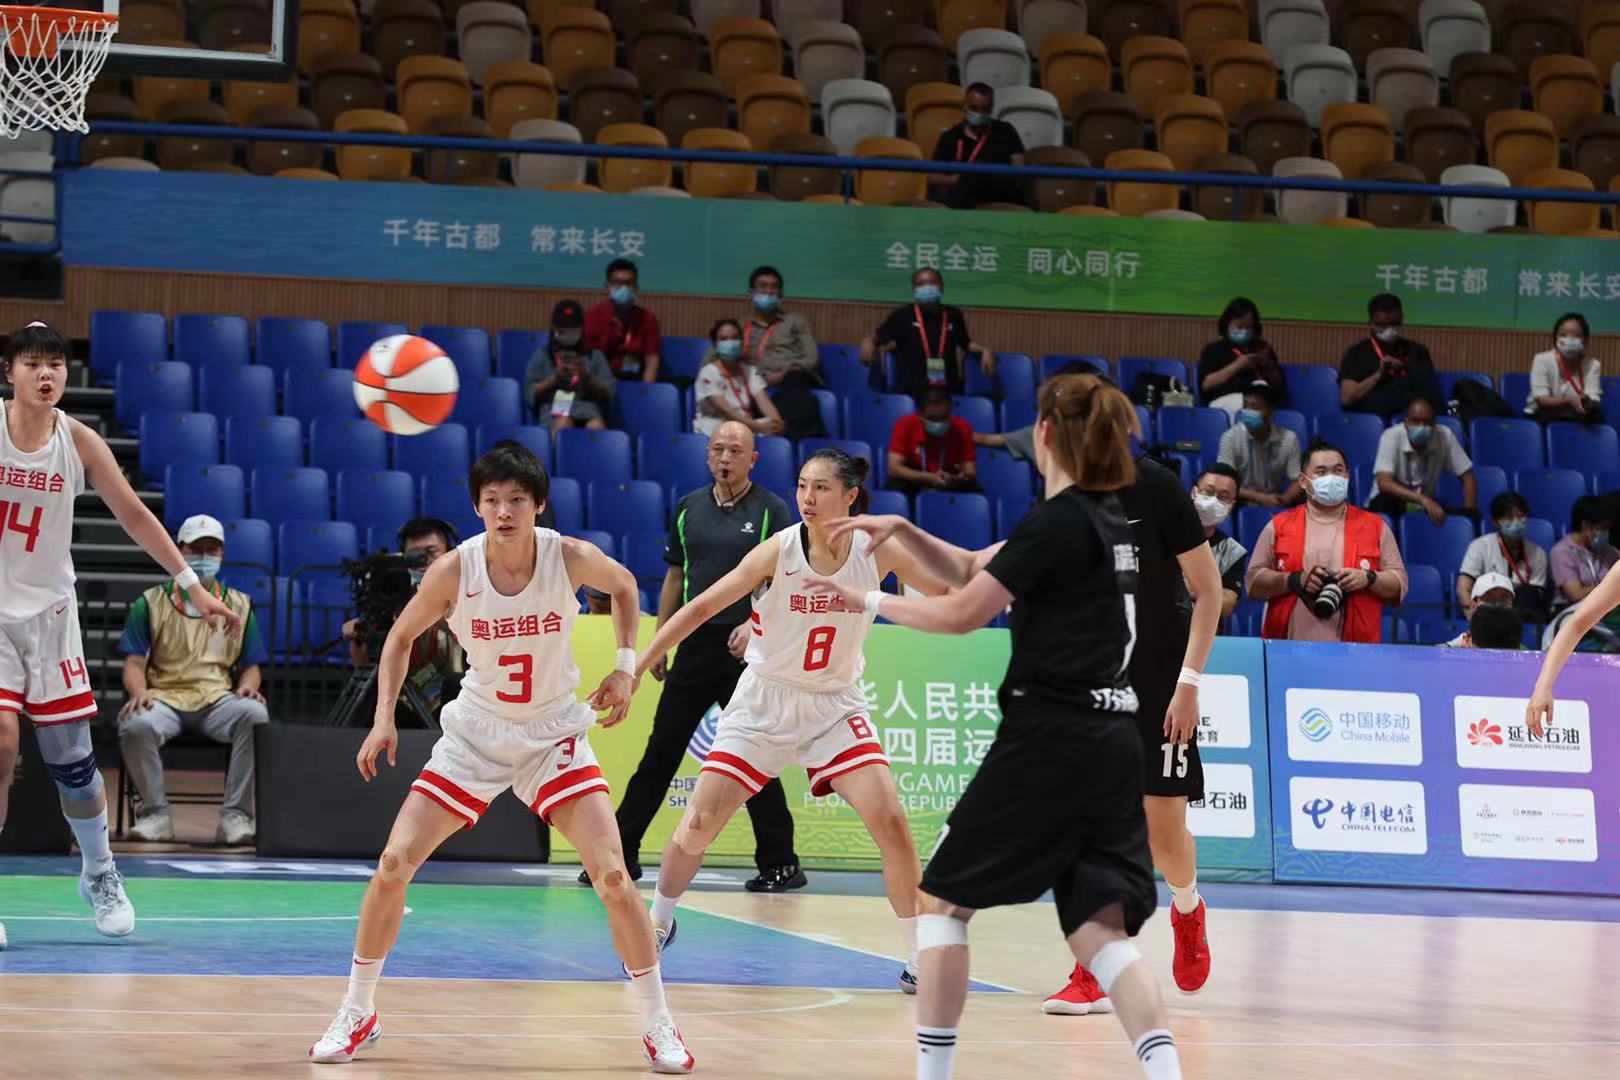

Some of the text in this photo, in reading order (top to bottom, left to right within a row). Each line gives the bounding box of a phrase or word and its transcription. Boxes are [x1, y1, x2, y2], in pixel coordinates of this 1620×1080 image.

[383, 218, 646, 257] 千年古都 常来长安
[885, 241, 1141, 278] 全民全运 同心同行
[1376, 264, 1488, 294] 千年古都
[0, 465, 65, 493] 运组合
[789, 594, 863, 614] 奥运
[471, 611, 562, 640] 奥运组合
[803, 626, 836, 671] 8
[59, 657, 87, 689] 14
[496, 654, 533, 703] 3
[847, 715, 873, 739] 8
[1339, 711, 1410, 730] 中国移动
[1340, 730, 1411, 744] China Mobile
[555, 737, 576, 770] 3
[1161, 743, 1188, 778] 15
[1341, 800, 1415, 824] 中国电信
[1341, 824, 1416, 833] CHINA TELECOM
